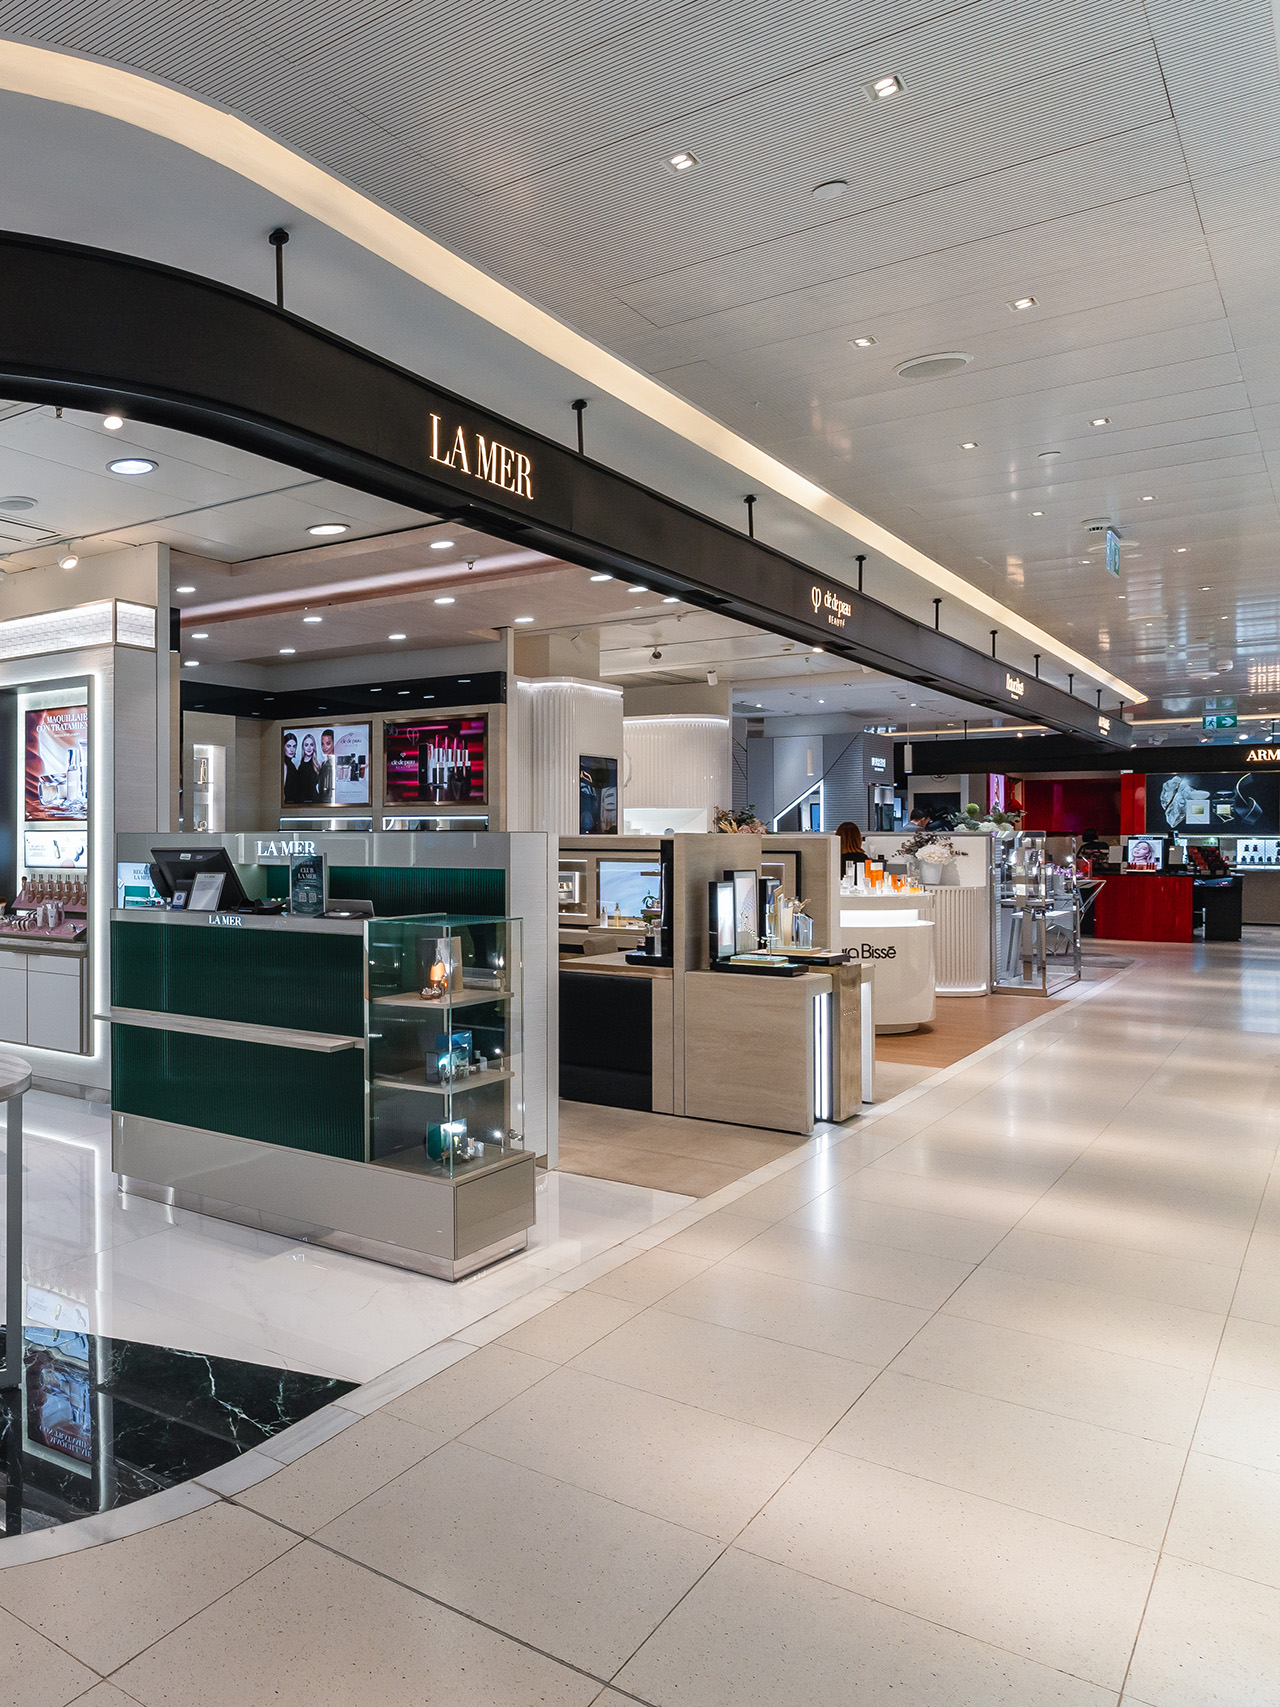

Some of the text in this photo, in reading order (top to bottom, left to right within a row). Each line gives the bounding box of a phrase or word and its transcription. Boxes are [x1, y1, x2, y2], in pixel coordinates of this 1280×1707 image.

[429, 413, 534, 500] LA MER
[46, 712, 88, 724] MAQUILLAJE
[36, 724, 51, 733] CON
[257, 840, 316, 856] LA MER
[208, 914, 242, 926] LA MER
